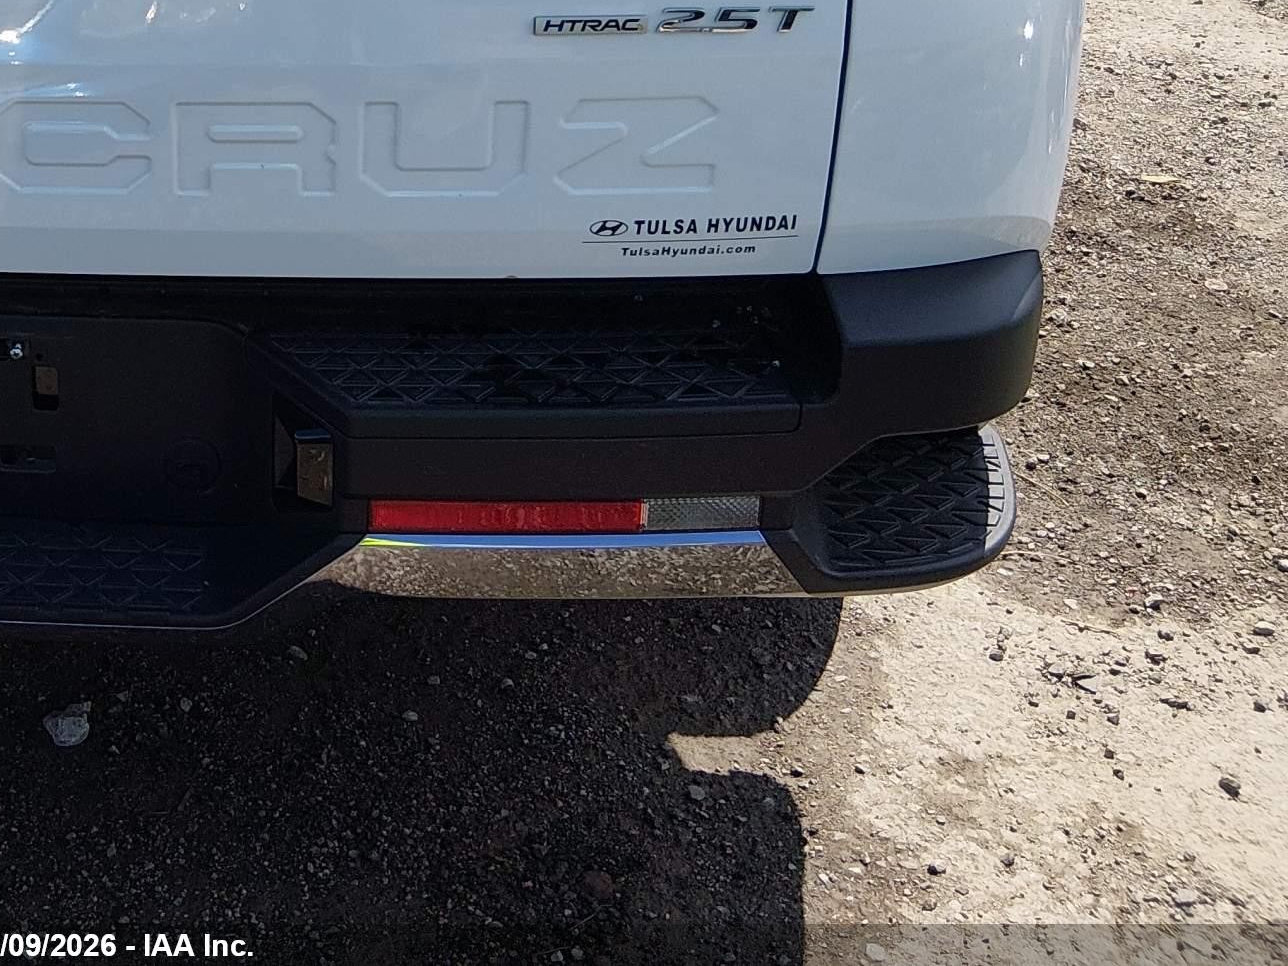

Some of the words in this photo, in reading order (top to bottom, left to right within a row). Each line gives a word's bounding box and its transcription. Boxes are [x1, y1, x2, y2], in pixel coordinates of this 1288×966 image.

[543, 19, 641, 32] HTRAC
[634, 219, 698, 235] TULSA
[707, 215, 797, 233] HYUNDAI
[621, 245, 756, 258] TulsaHyundai.com
